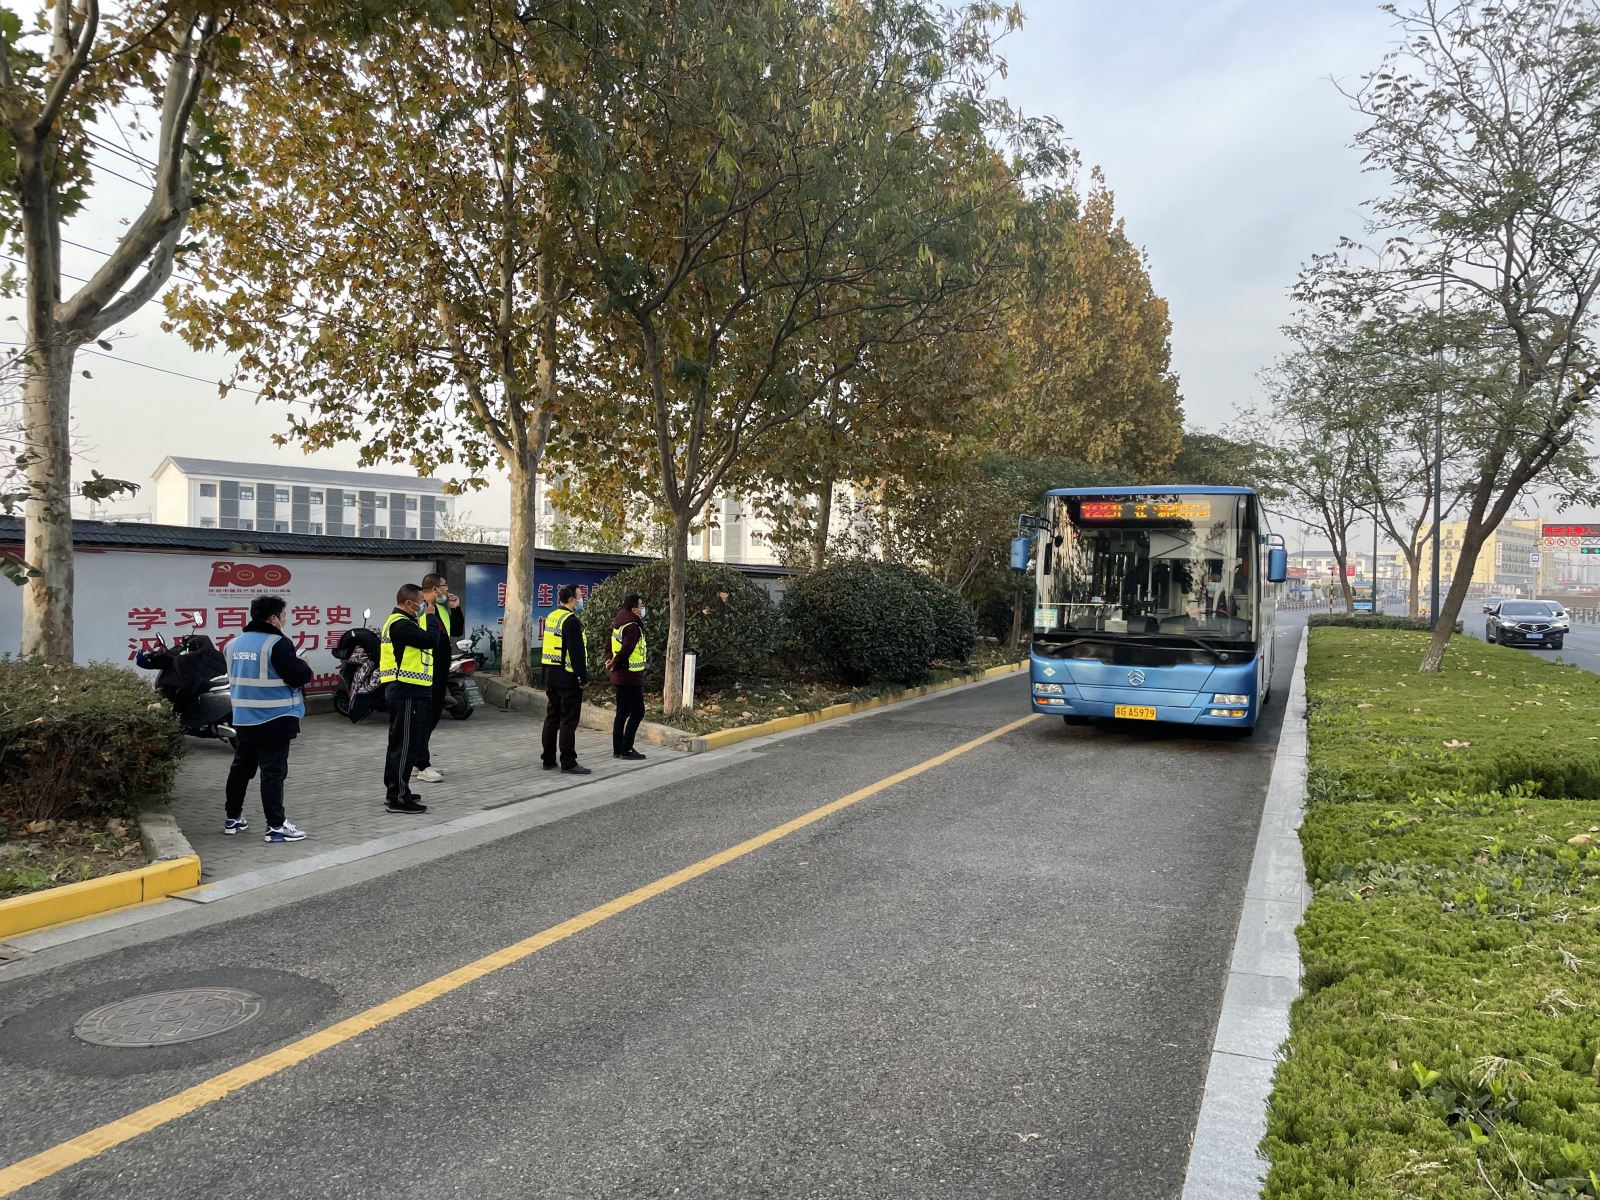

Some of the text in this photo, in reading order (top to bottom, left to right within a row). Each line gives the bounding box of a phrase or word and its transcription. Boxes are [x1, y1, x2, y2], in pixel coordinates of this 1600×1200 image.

[127, 605, 353, 631] 学习百党史
